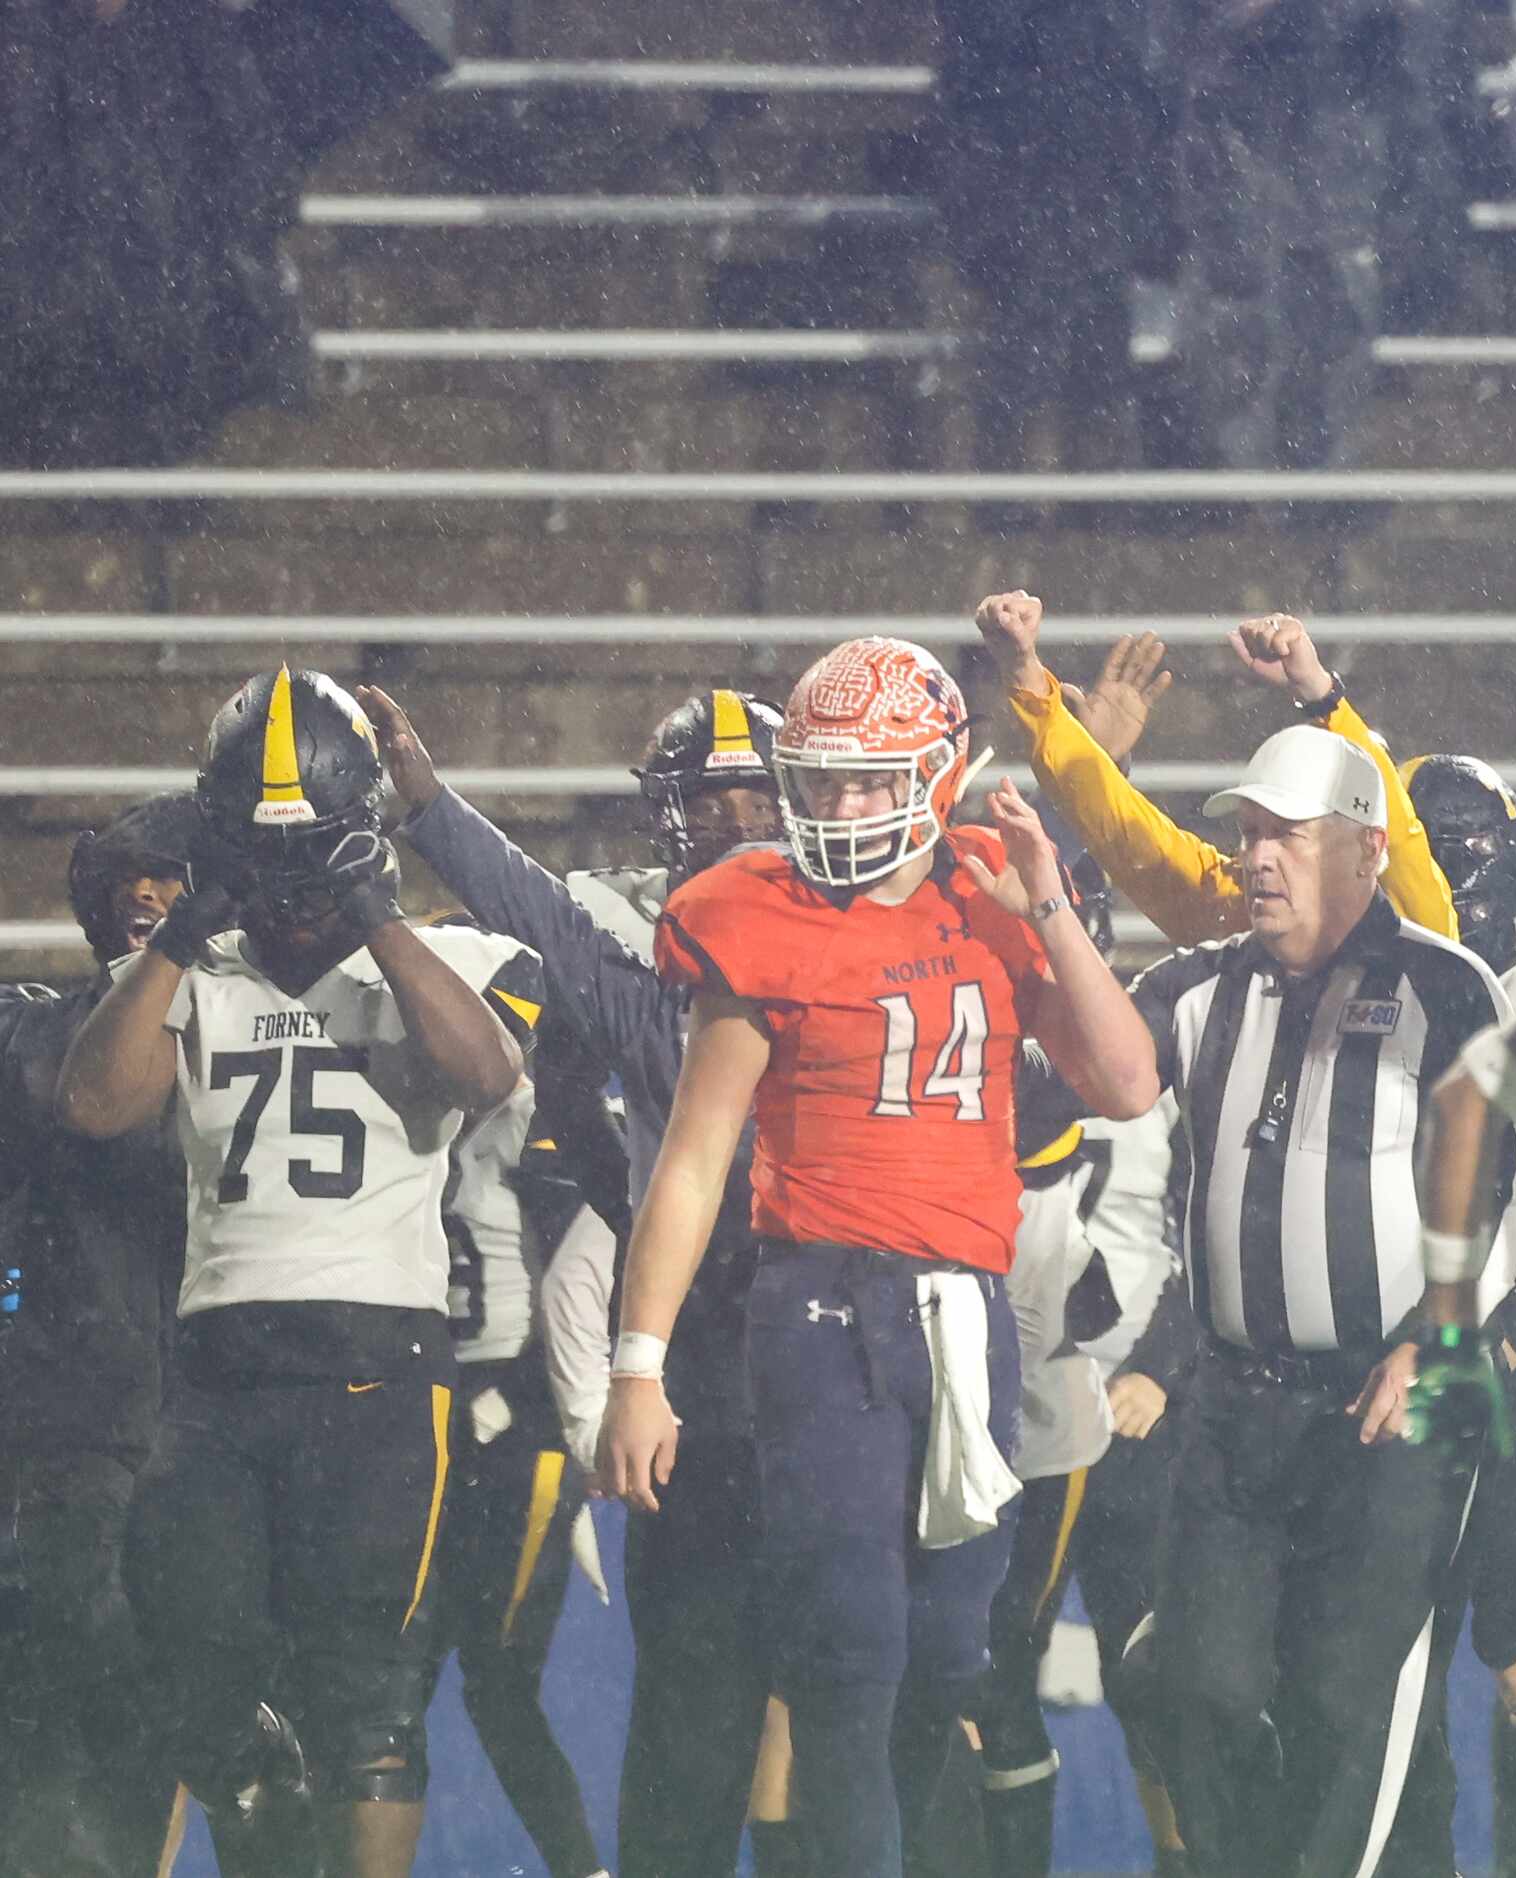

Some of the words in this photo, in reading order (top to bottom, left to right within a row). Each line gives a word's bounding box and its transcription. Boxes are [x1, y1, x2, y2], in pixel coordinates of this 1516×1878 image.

[882, 955, 958, 983] NORTH
[252, 1011, 331, 1042] FORNEY
[867, 980, 990, 1121] 14
[209, 1045, 368, 1204] 75
